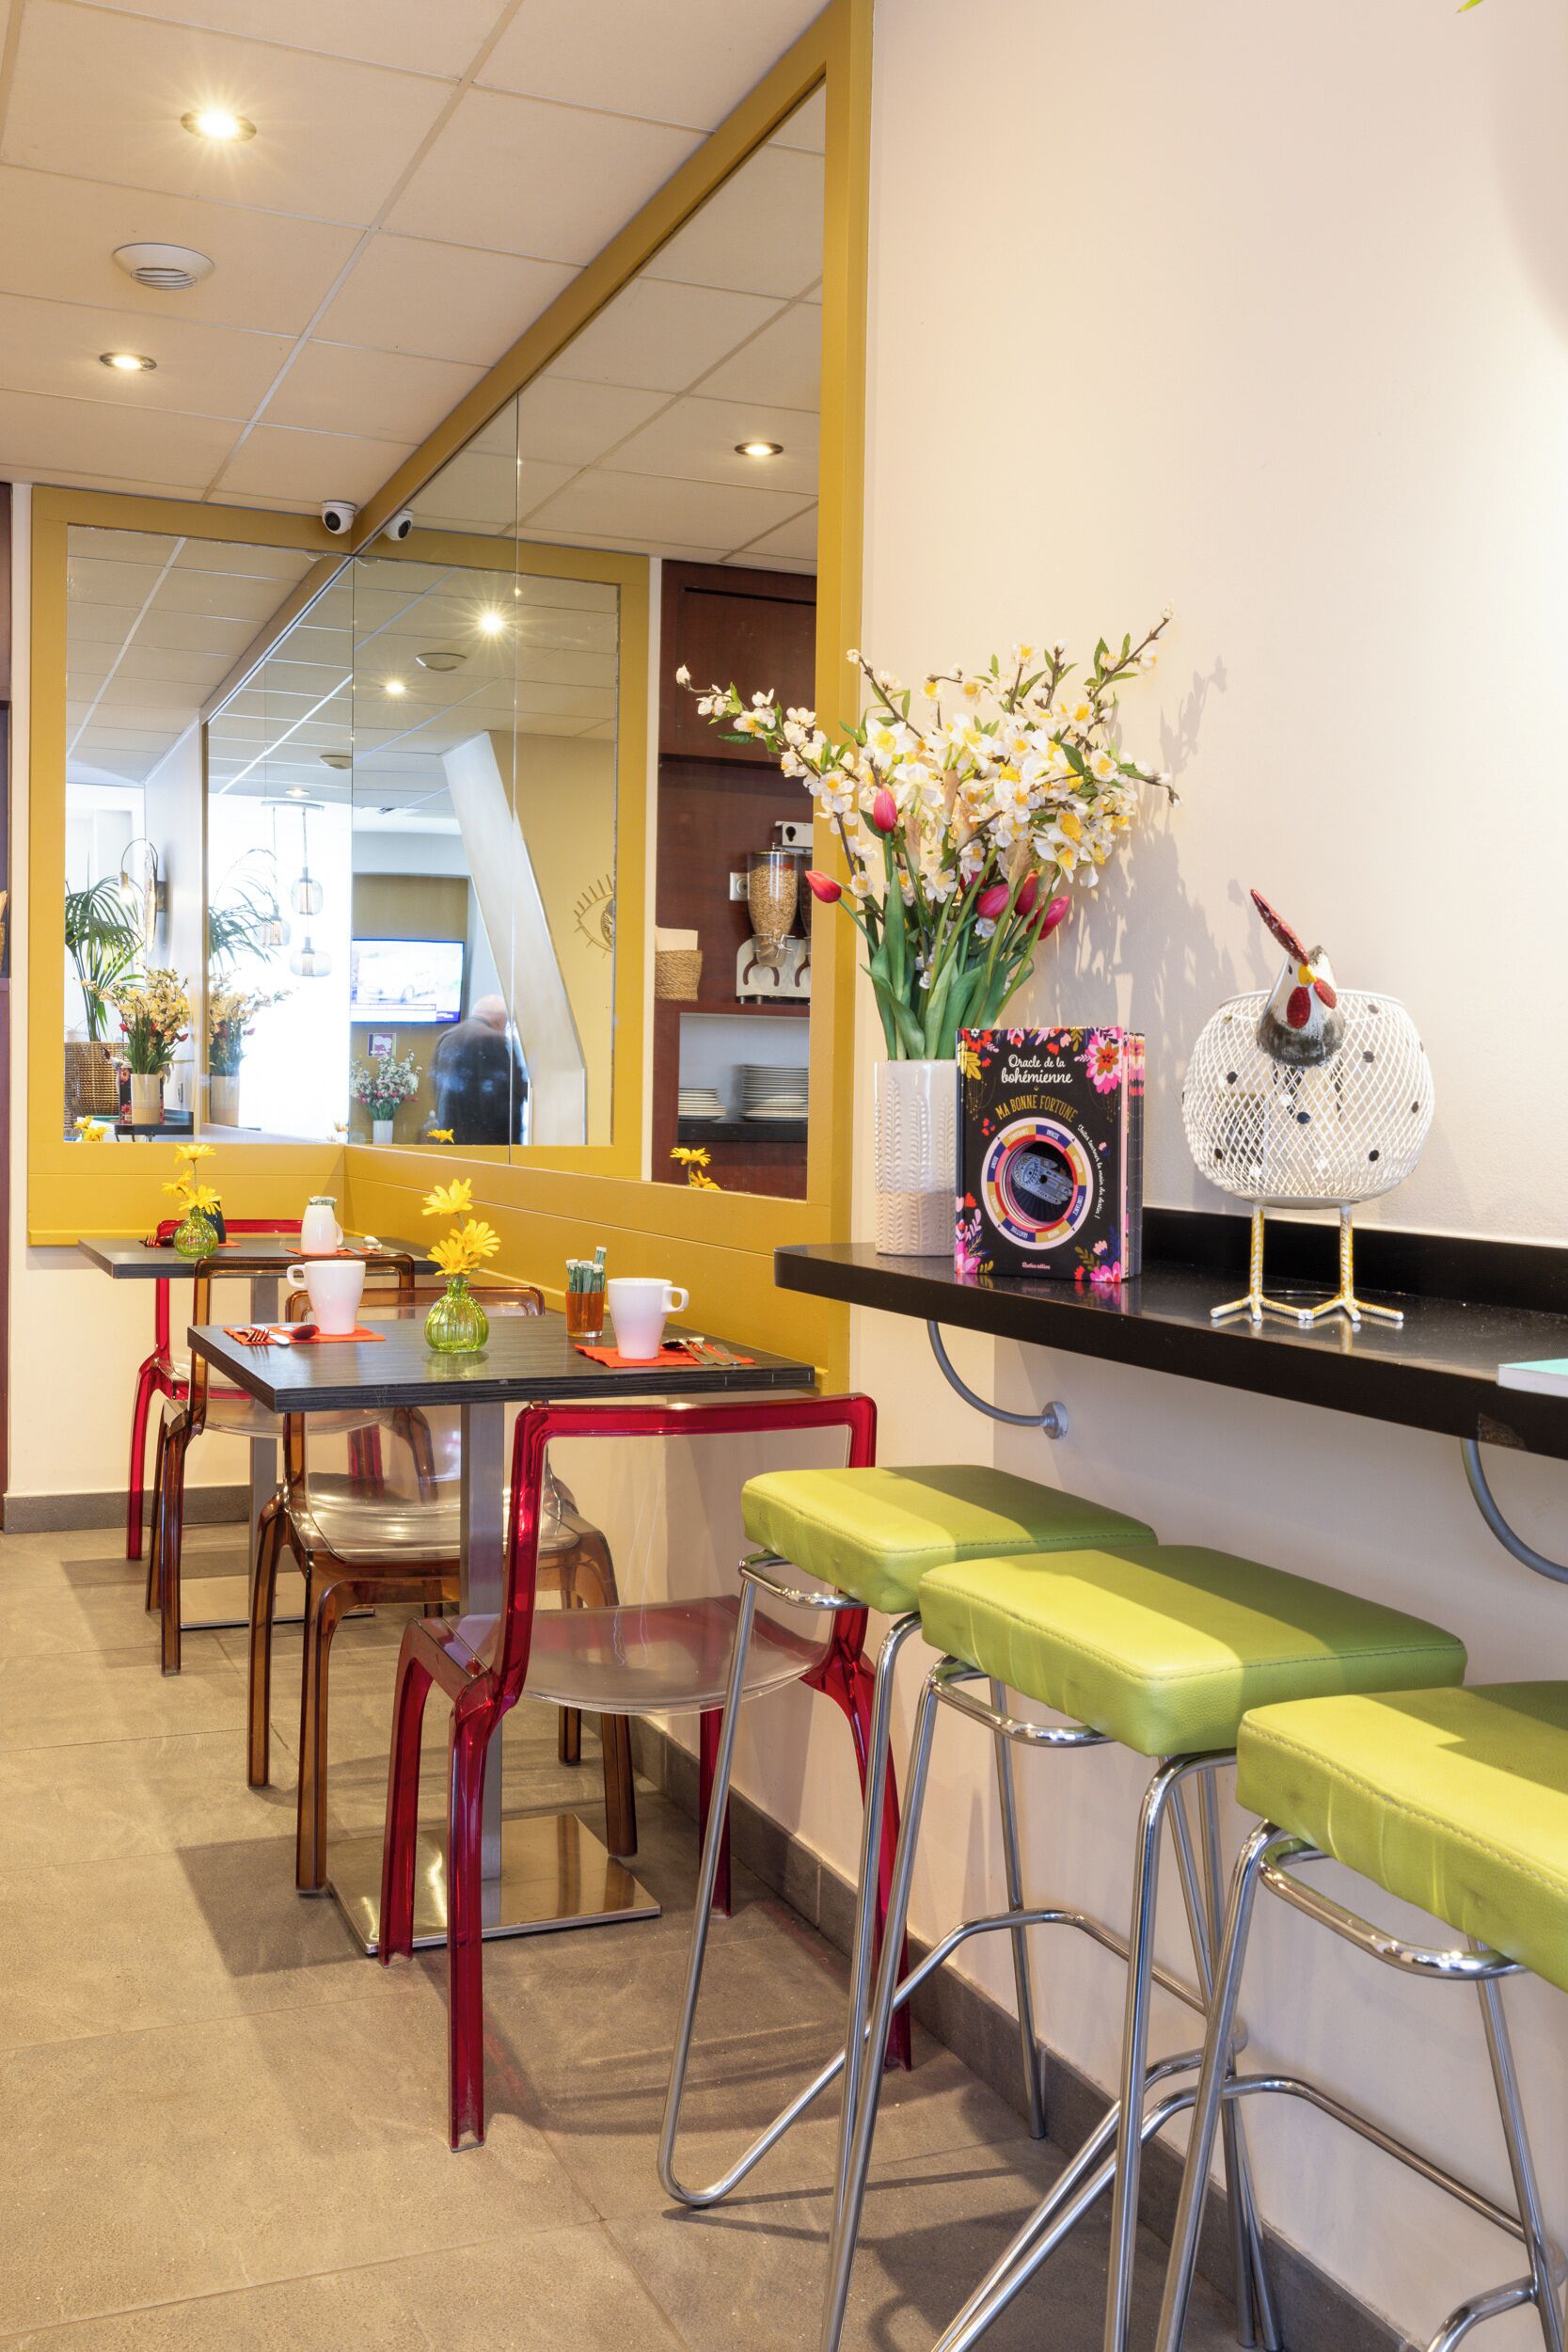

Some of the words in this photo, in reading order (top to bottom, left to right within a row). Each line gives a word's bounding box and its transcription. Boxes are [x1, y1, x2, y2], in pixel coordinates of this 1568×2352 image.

[1008, 1054, 1041, 1068] Oracle
[1044, 1056, 1054, 1068] de
[1055, 1057, 1066, 1068] la
[1001, 1067, 1073, 1084] bohémienne
[995, 1103, 1011, 1120] MA
[1009, 1094, 1037, 1114] BONNE
[1039, 1094, 1079, 1122] FORTUNE
